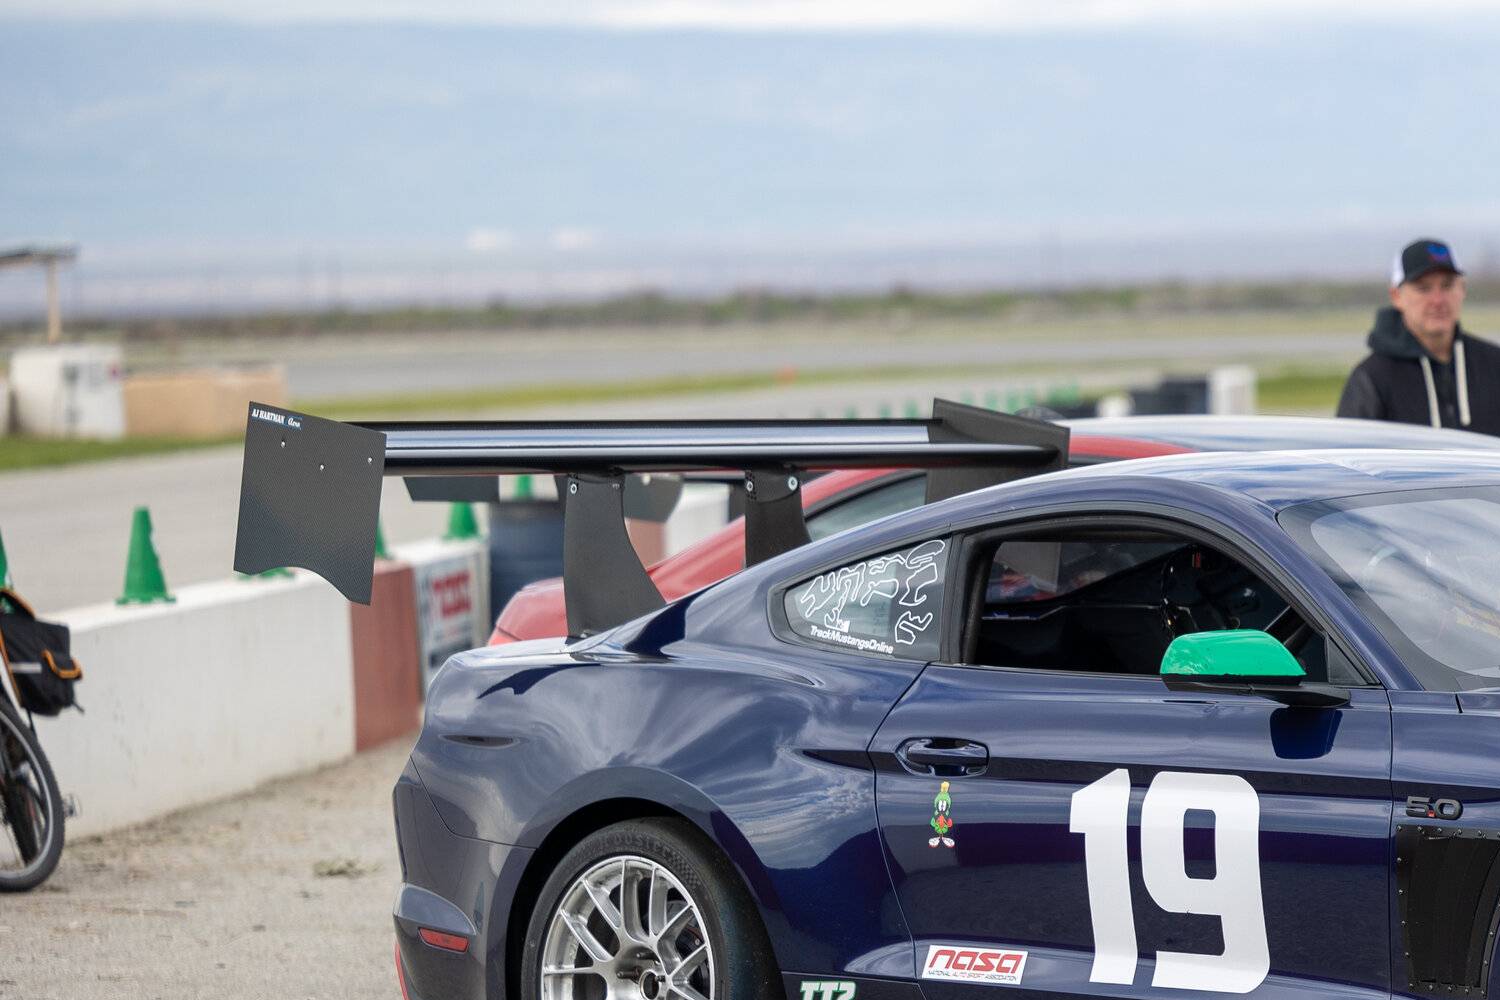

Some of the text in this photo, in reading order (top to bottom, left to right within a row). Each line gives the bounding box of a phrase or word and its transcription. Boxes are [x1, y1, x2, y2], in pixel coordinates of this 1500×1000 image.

[252, 409, 259, 417] AJ
[259, 411, 285, 424] HARTMAN
[1406, 796, 1463, 821] 5.0
[1069, 768, 1271, 994] 19
[928, 949, 1024, 974] nasa
